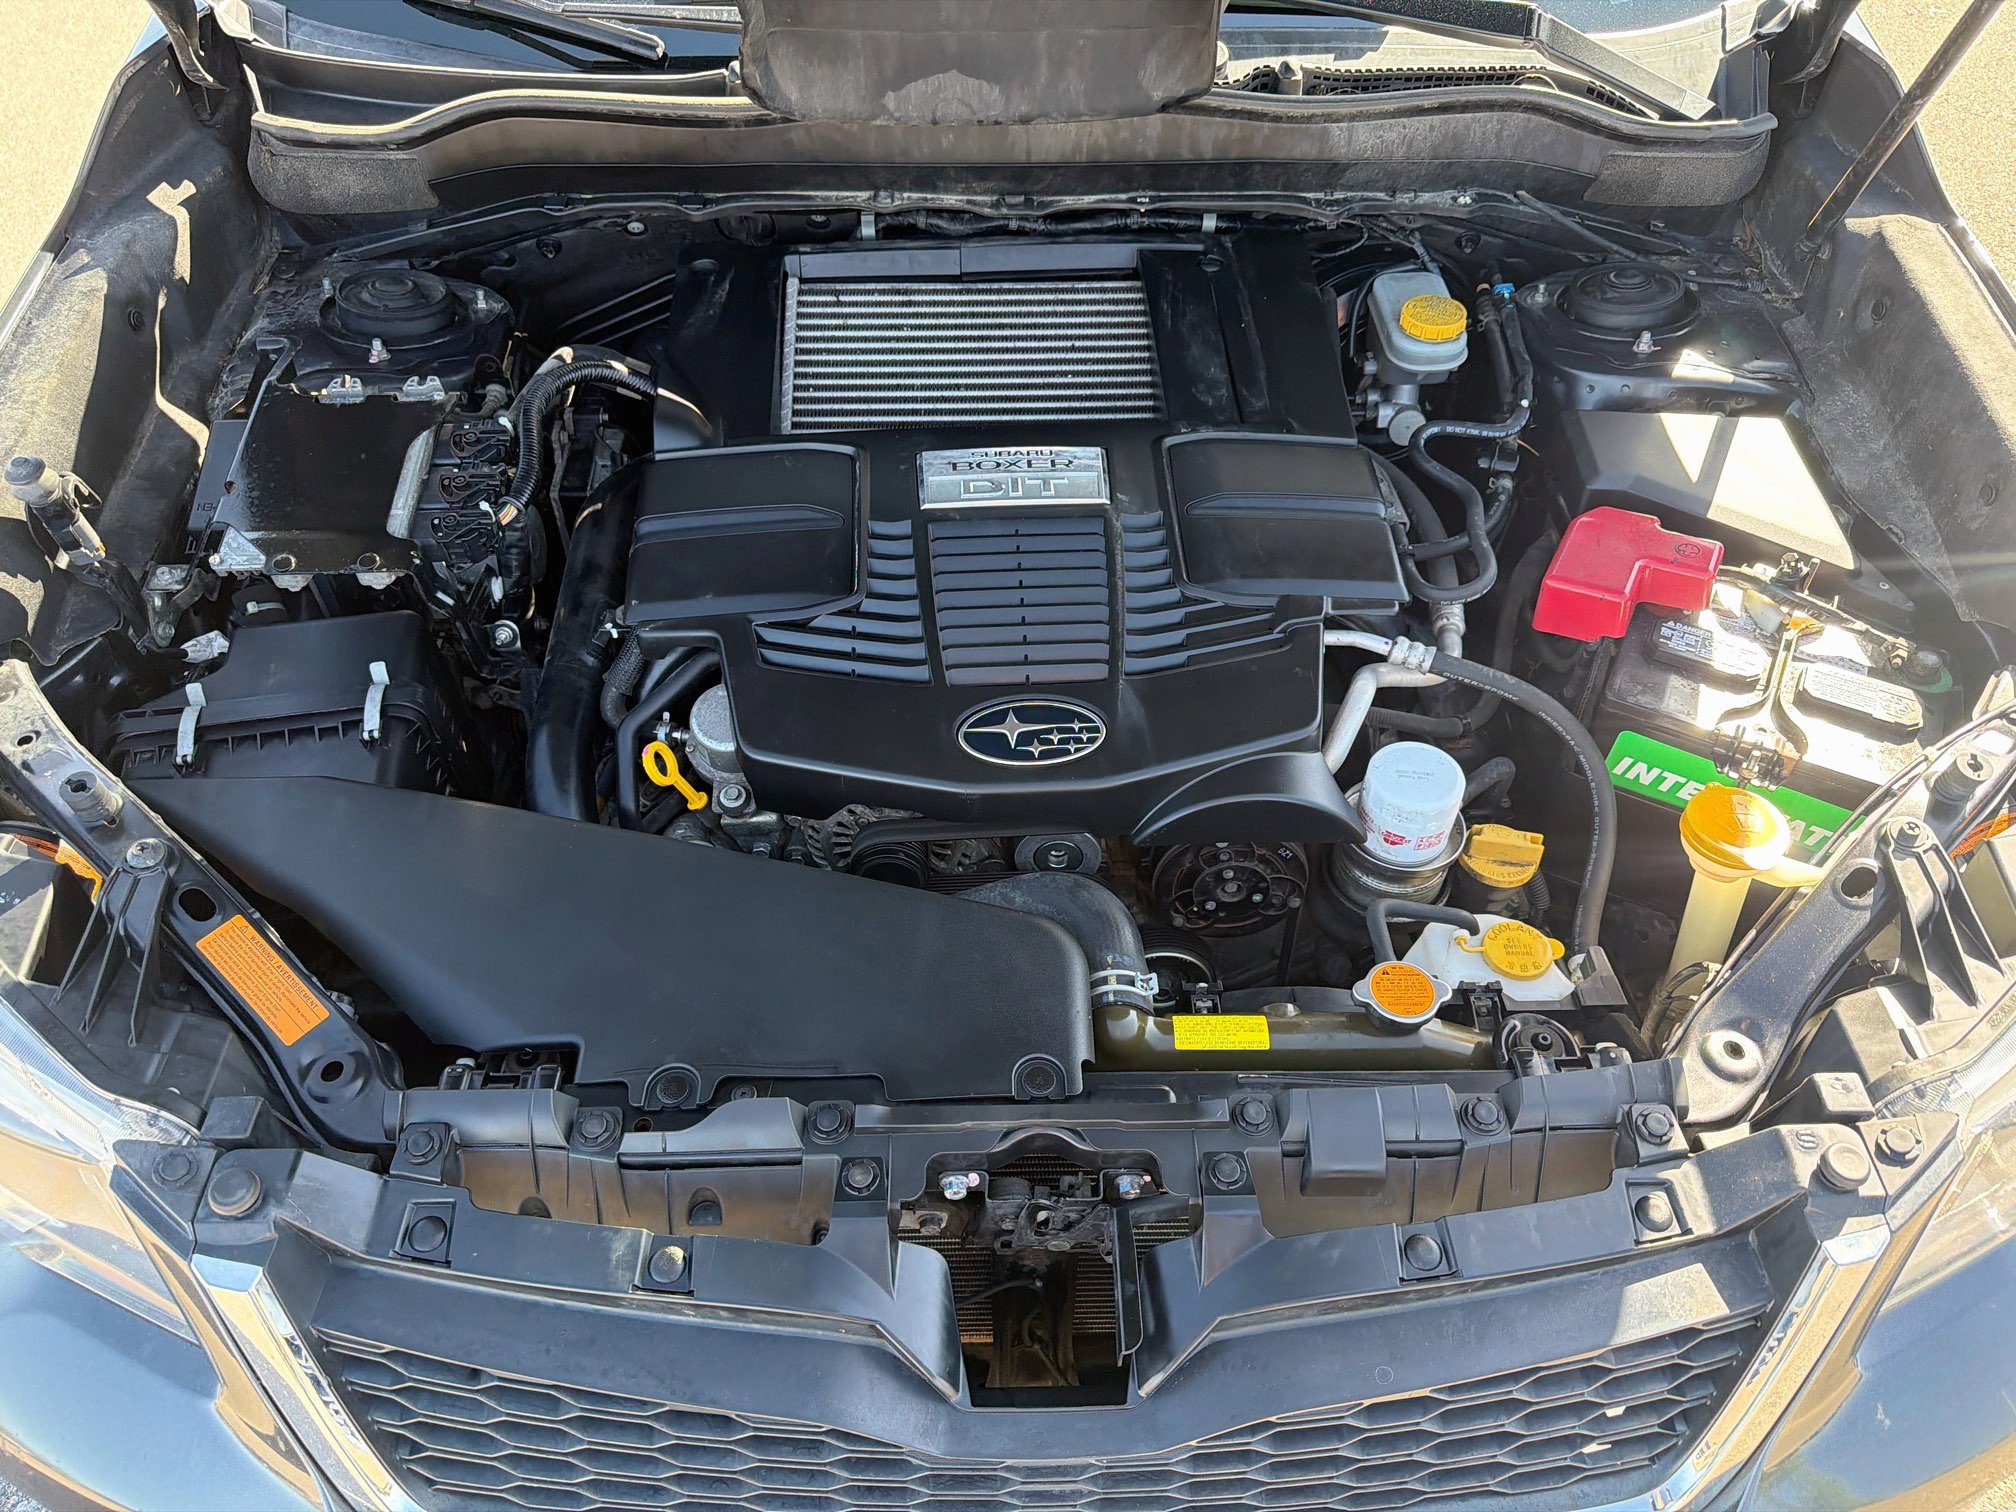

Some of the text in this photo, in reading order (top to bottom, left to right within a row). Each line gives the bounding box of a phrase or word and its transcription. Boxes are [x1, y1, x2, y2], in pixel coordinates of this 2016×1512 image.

[971, 450, 1053, 459] SUBARU
[951, 458, 1074, 472] BOXER
[960, 477, 1069, 499] DIT
[1674, 622, 1713, 640] DANGER
[249, 935, 276, 962] WARNING
[275, 963, 319, 1010] AVERTISSEMENT
